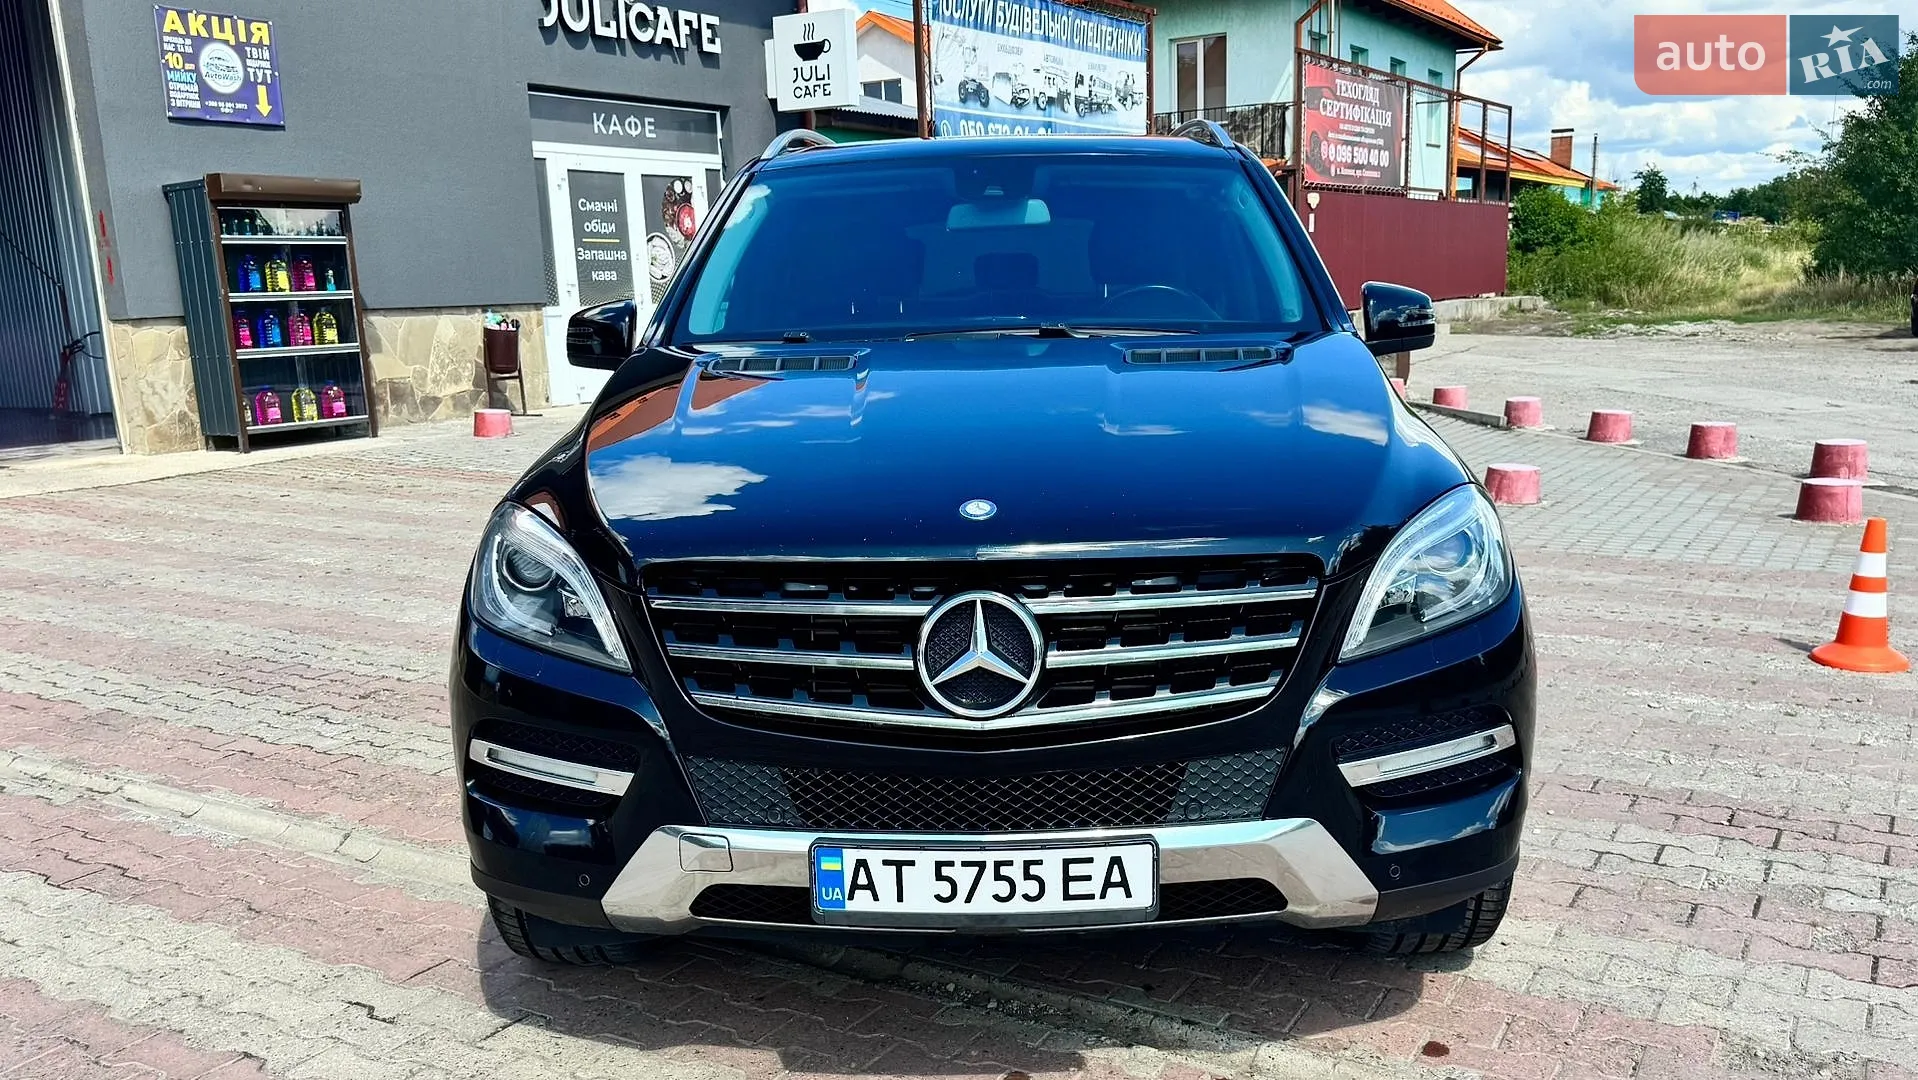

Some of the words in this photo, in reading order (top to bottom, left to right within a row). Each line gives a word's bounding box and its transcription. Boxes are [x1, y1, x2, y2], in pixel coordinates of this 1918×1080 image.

[163, 10, 270, 45] АКЦІЯ
[996, 1, 1071, 41] БУДІВЕЛЬНОЇ
[1073, 19, 1142, 56] СПЕЦТЕХНІКИ
[165, 52, 183, 69] 10
[245, 47, 270, 60] ТВІЙ
[167, 69, 197, 84] МИЙКУ
[247, 68, 272, 83] ТУТ
[793, 64, 830, 83] JULI
[793, 83, 831, 99] CAFE
[1335, 79, 1379, 107] ТЕХОГЛЯД
[1320, 98, 1392, 129] СЕРТИФІКАЦІЯ
[593, 112, 657, 138] КАФЕ
[1336, 144, 1352, 163] 096
[1353, 146, 1368, 165] 500
[1380, 150, 1390, 167] 00
[578, 198, 618, 213] Смачні
[584, 219, 616, 235] обіди
[577, 248, 627, 261] Запашна
[592, 270, 617, 281] кава
[847, 858, 916, 903] AT
[934, 860, 1046, 904] 5755
[1062, 856, 1133, 902] EA
[822, 887, 843, 901] UA
